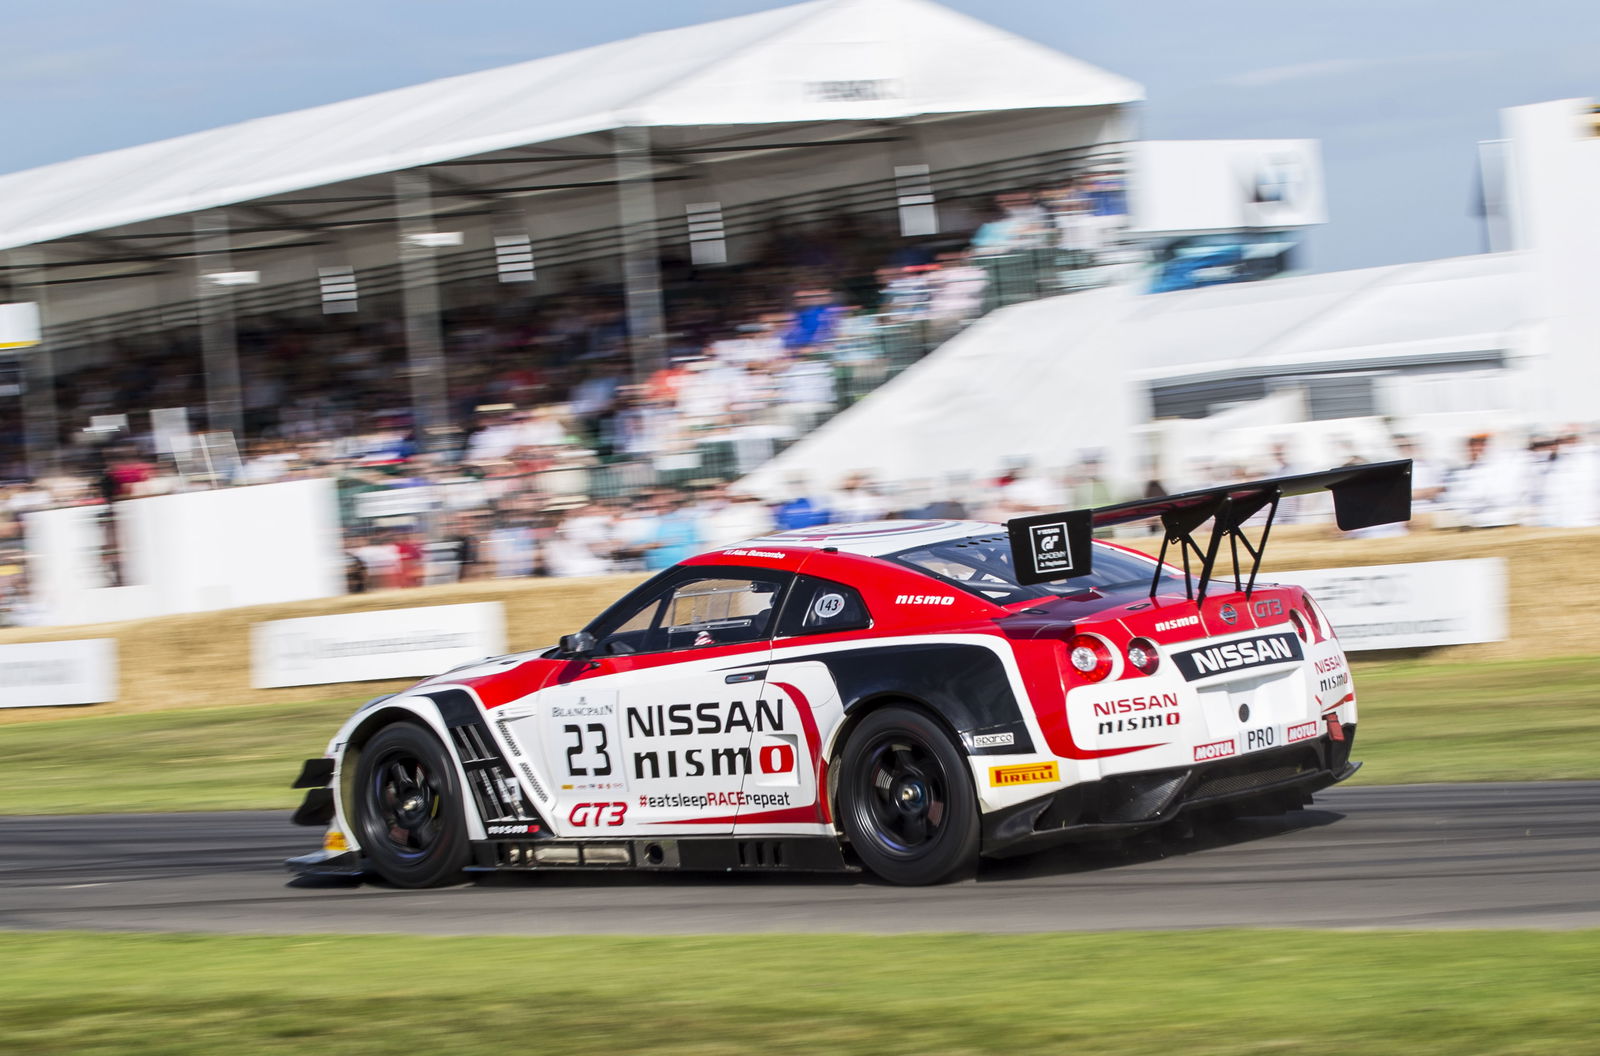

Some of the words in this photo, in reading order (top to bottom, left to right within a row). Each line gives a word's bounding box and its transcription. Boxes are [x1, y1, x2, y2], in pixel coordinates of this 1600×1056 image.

[819, 599, 839, 611] 143
[1254, 599, 1283, 618] GT3
[1191, 637, 1293, 675] NISSAN
[1093, 692, 1179, 717] NISSAN
[627, 699, 784, 738] NISSAN
[1098, 712, 1181, 735] nismo
[1248, 726, 1275, 750] PRO
[1289, 723, 1317, 742] MOTUL
[564, 723, 612, 777] 23
[1194, 741, 1235, 761] MOTUL
[634, 744, 795, 780] nismo
[994, 764, 1054, 784] PIRELLI
[639, 791, 791, 809] #eatsleepRACErepeat
[568, 802, 628, 827] GT3
